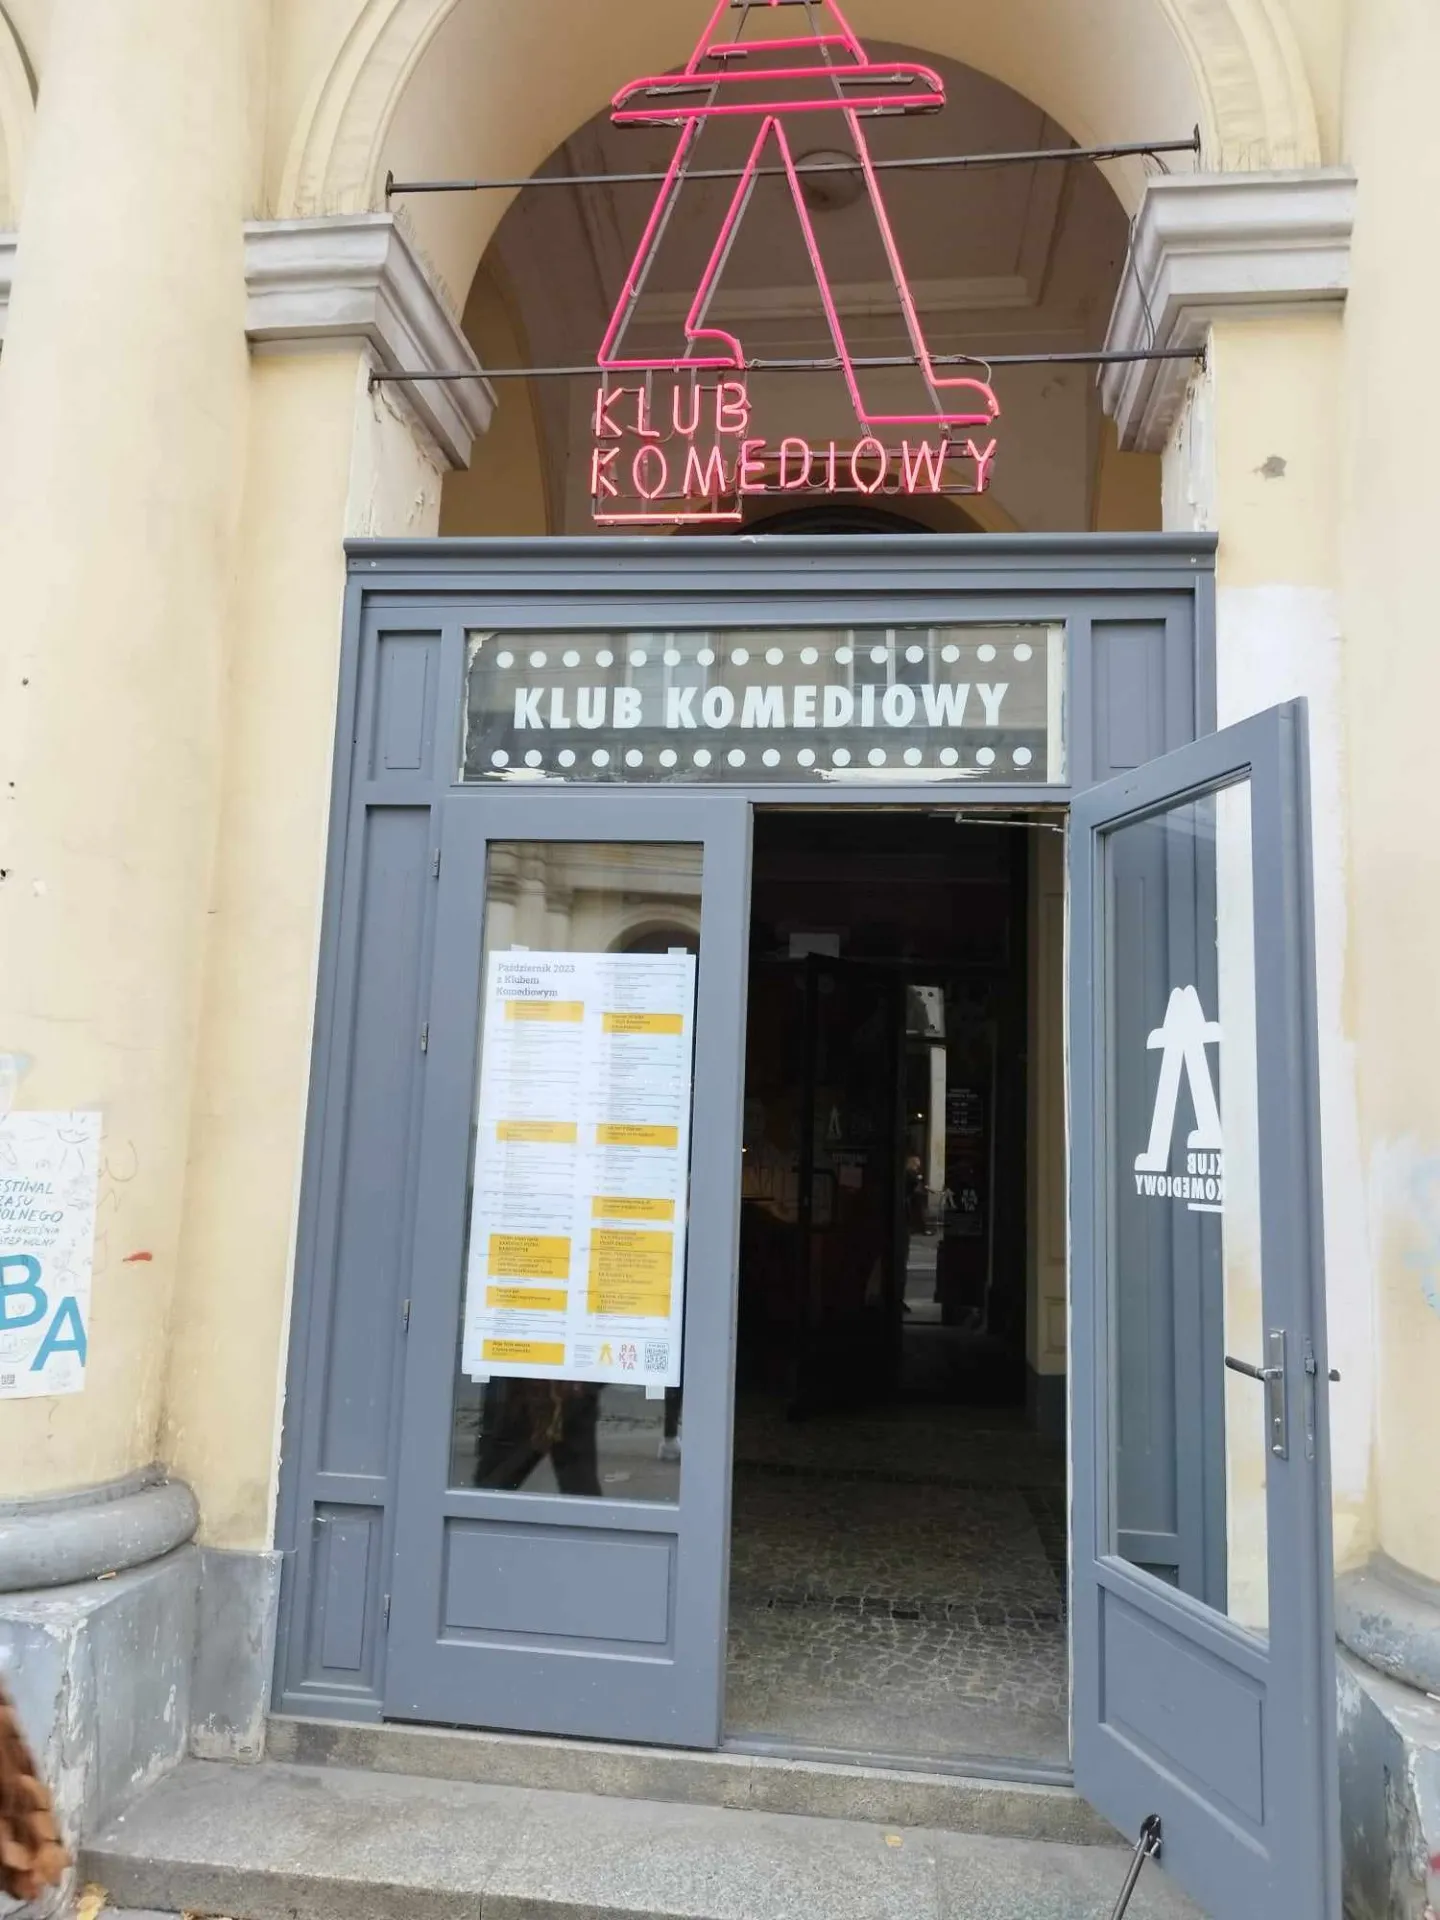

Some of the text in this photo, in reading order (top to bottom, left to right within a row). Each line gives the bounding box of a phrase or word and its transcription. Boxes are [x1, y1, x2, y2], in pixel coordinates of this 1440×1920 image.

[594, 382, 748, 437] KLUB
[590, 437, 998, 498] KOMEDIOWY
[513, 683, 1010, 730] KLUB KOMEDIOWY
[553, 964, 576, 974] 2023
[504, 975, 540, 985] Klubem
[495, 986, 559, 998] Komediowym
[0, 1207, 64, 1223] OLNEGO
